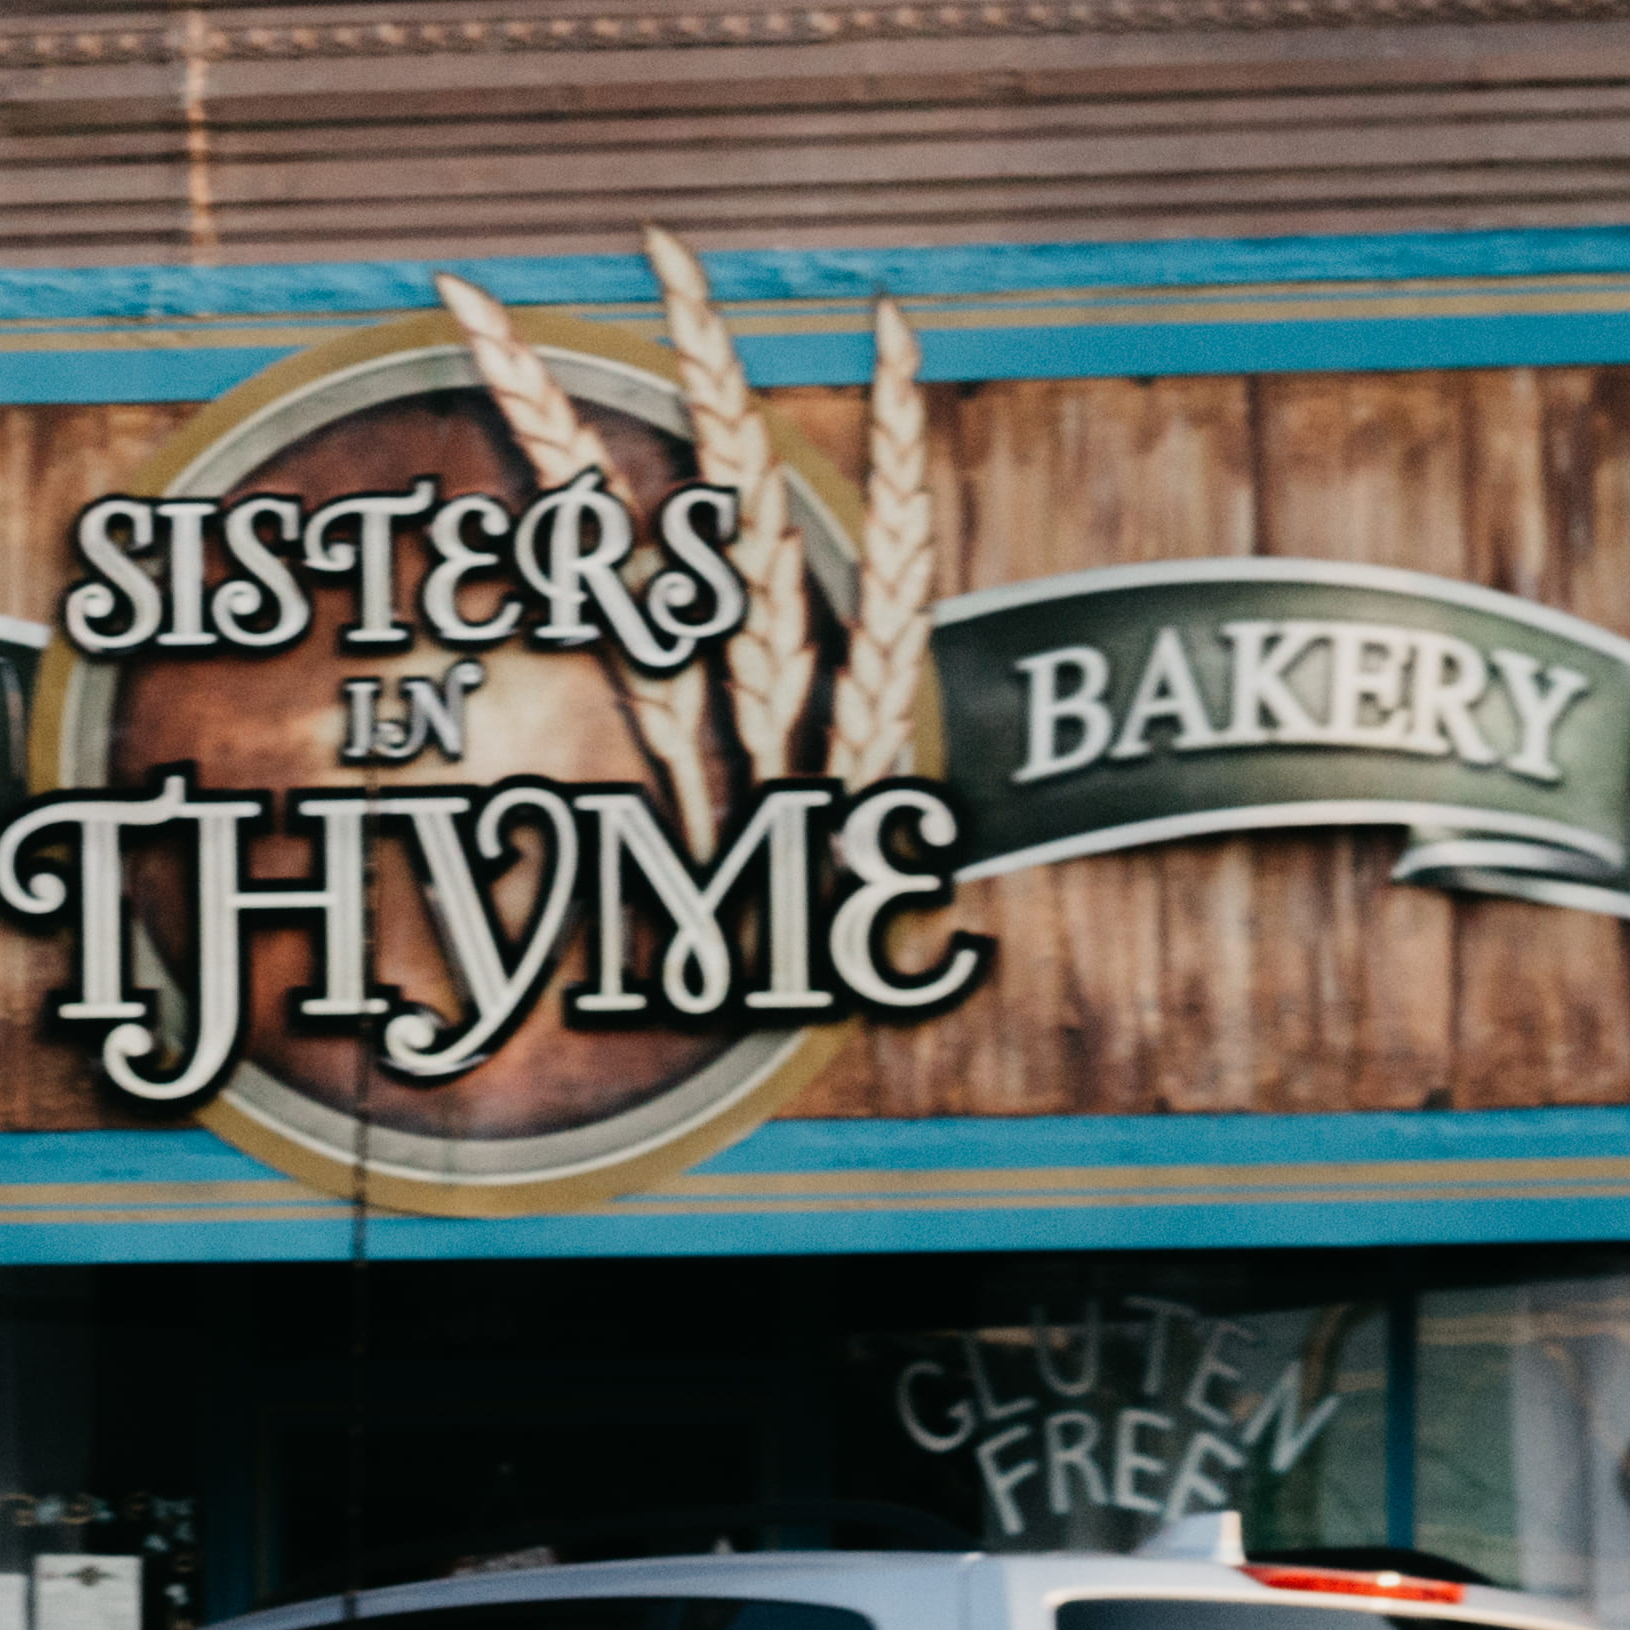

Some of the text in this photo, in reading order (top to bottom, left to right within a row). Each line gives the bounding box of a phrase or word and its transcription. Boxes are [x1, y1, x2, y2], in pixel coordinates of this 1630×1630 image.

[64, 466, 747, 672] SISTERS
[340, 658, 484, 763] IN
[1011, 620, 1589, 784] BAKERY
[897, 1295, 1341, 1473] GLUTEN
[975, 1410, 1247, 1536] FREE
